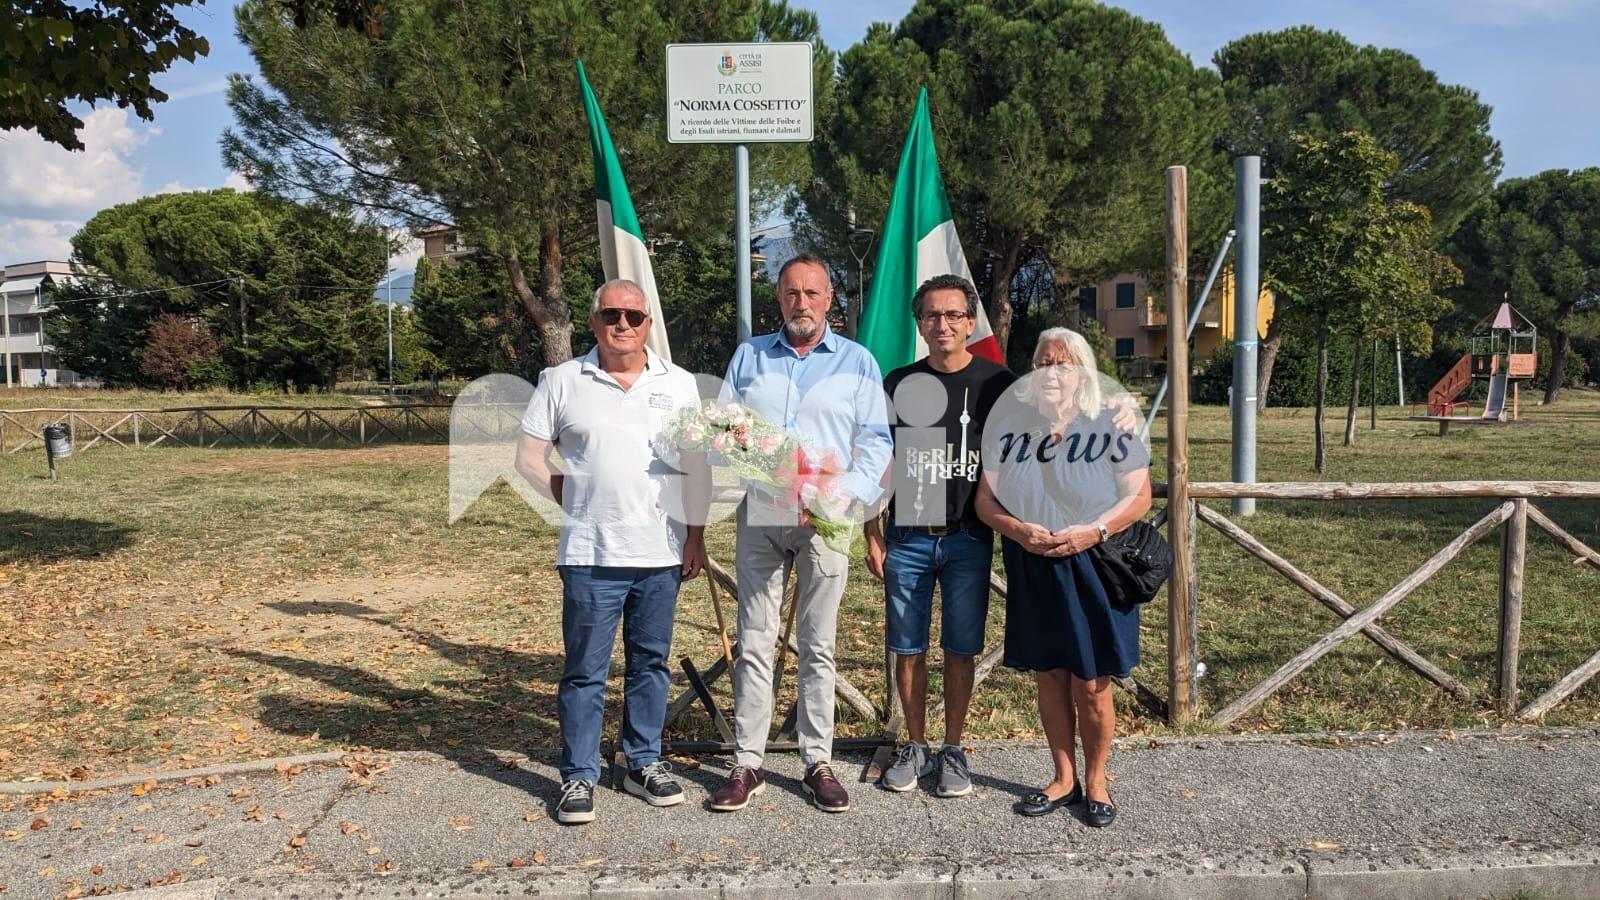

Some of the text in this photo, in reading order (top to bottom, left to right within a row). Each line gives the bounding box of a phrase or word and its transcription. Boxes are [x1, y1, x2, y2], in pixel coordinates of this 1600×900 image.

[739, 60, 762, 68] ASSISI
[718, 82, 762, 95] PARCO
[680, 127, 696, 136] degli
[716, 126, 741, 135] istriani,
